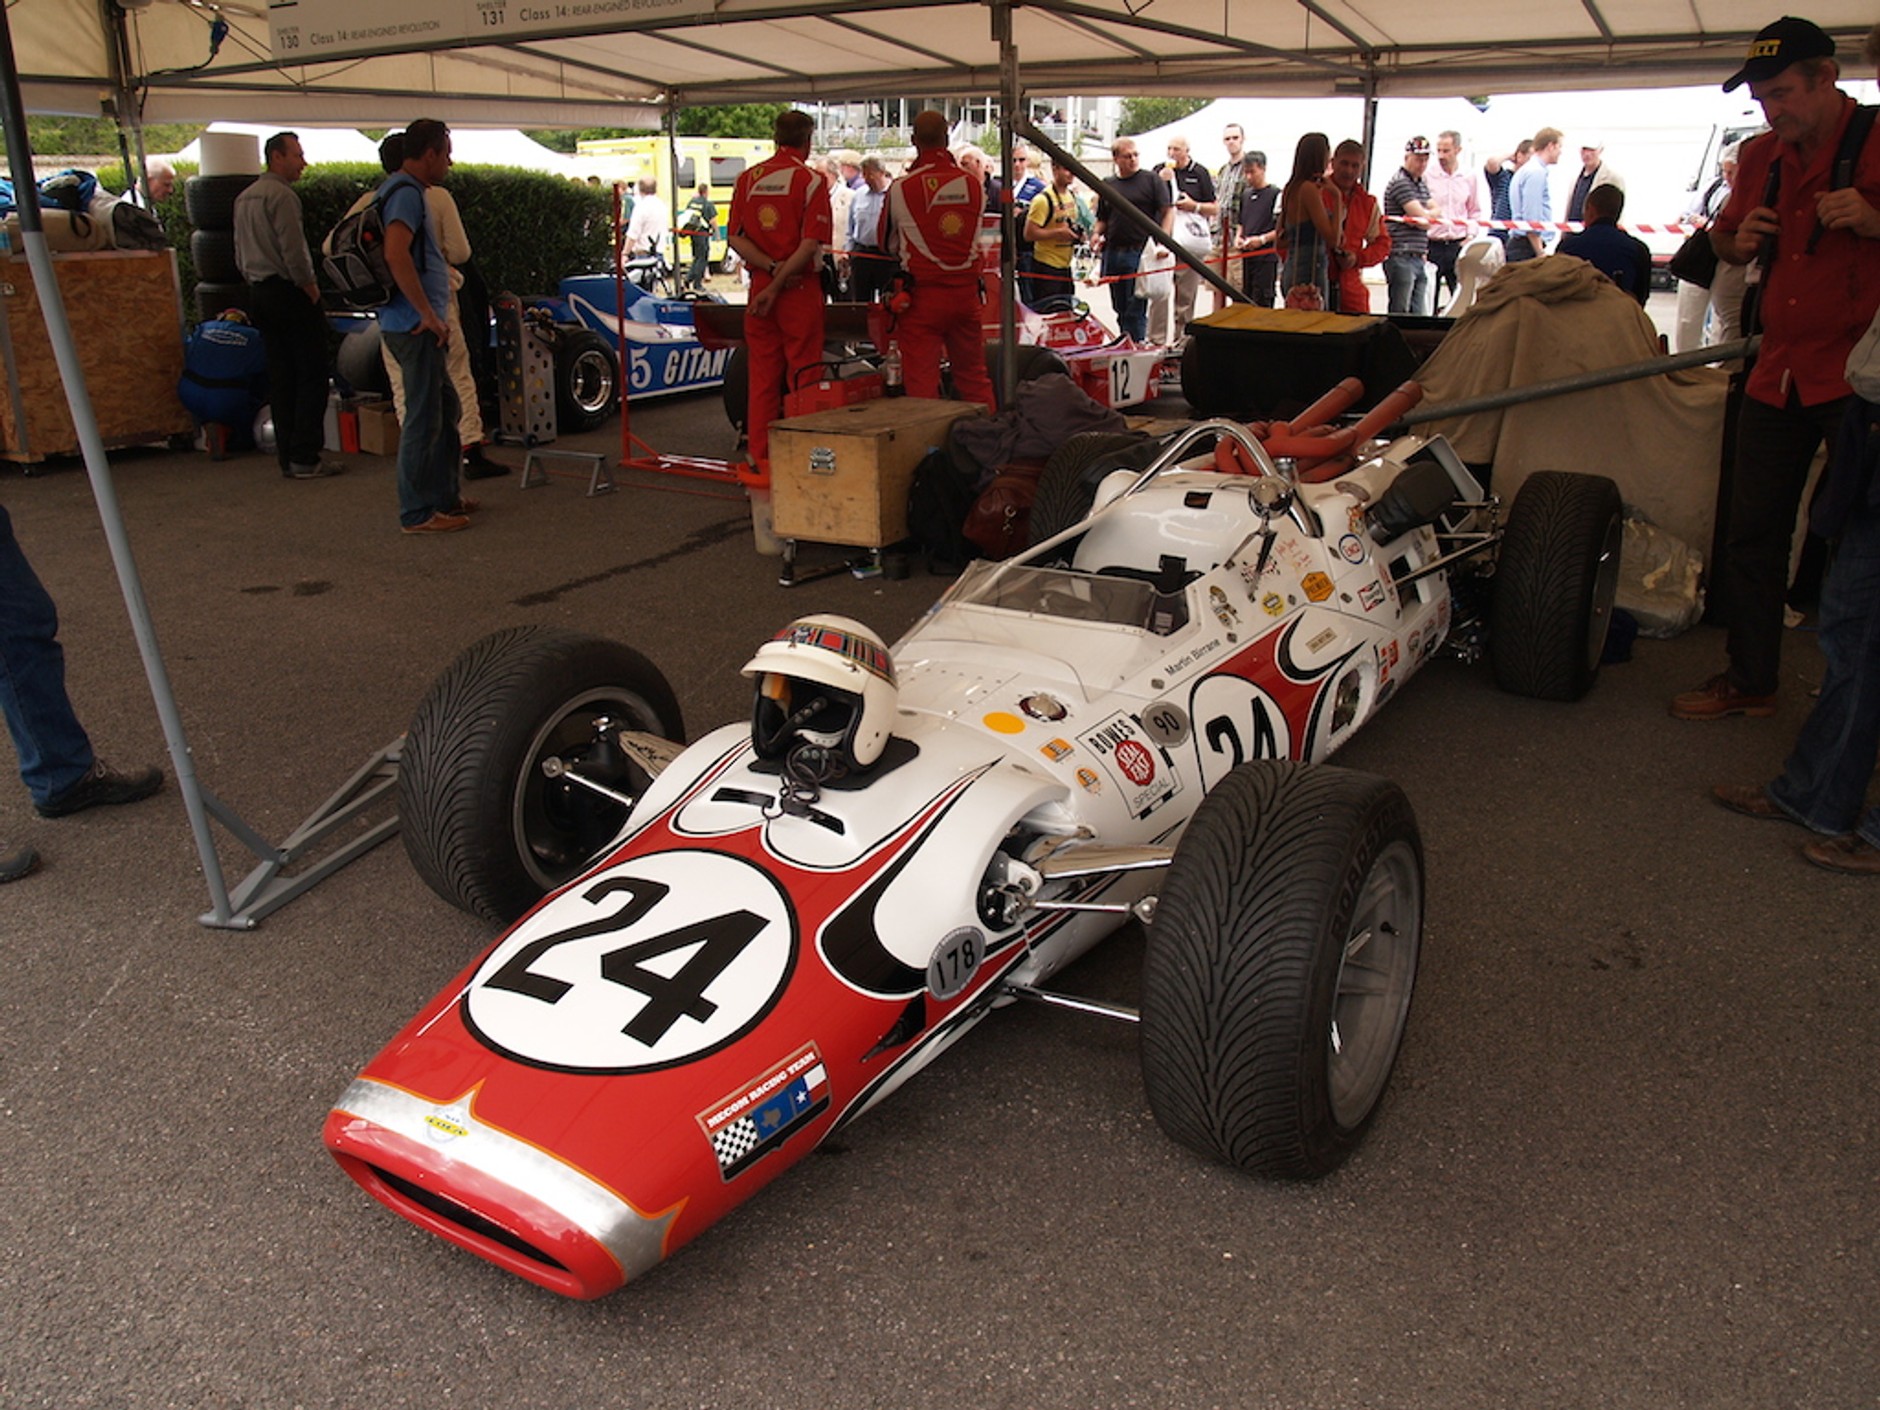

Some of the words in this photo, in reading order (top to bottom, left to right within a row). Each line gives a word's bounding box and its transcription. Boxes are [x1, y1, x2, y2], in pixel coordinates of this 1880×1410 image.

[482, 10, 504, 26] 131
[519, 8, 550, 21] Class
[555, 5, 570, 18] 14:
[280, 35, 299, 49] 130
[310, 31, 334, 46] Class
[1112, 358, 1130, 403] 12
[1164, 655, 1194, 677] Martin
[1087, 718, 1137, 755] BOWES
[1152, 710, 1181, 737] 90
[1205, 694, 1287, 771] 24
[481, 875, 772, 1049] 24
[936, 938, 976, 990] 178
[706, 1095, 751, 1129] MECOM
[747, 1070, 789, 1102] RACING
[786, 1051, 817, 1076] TEAM
